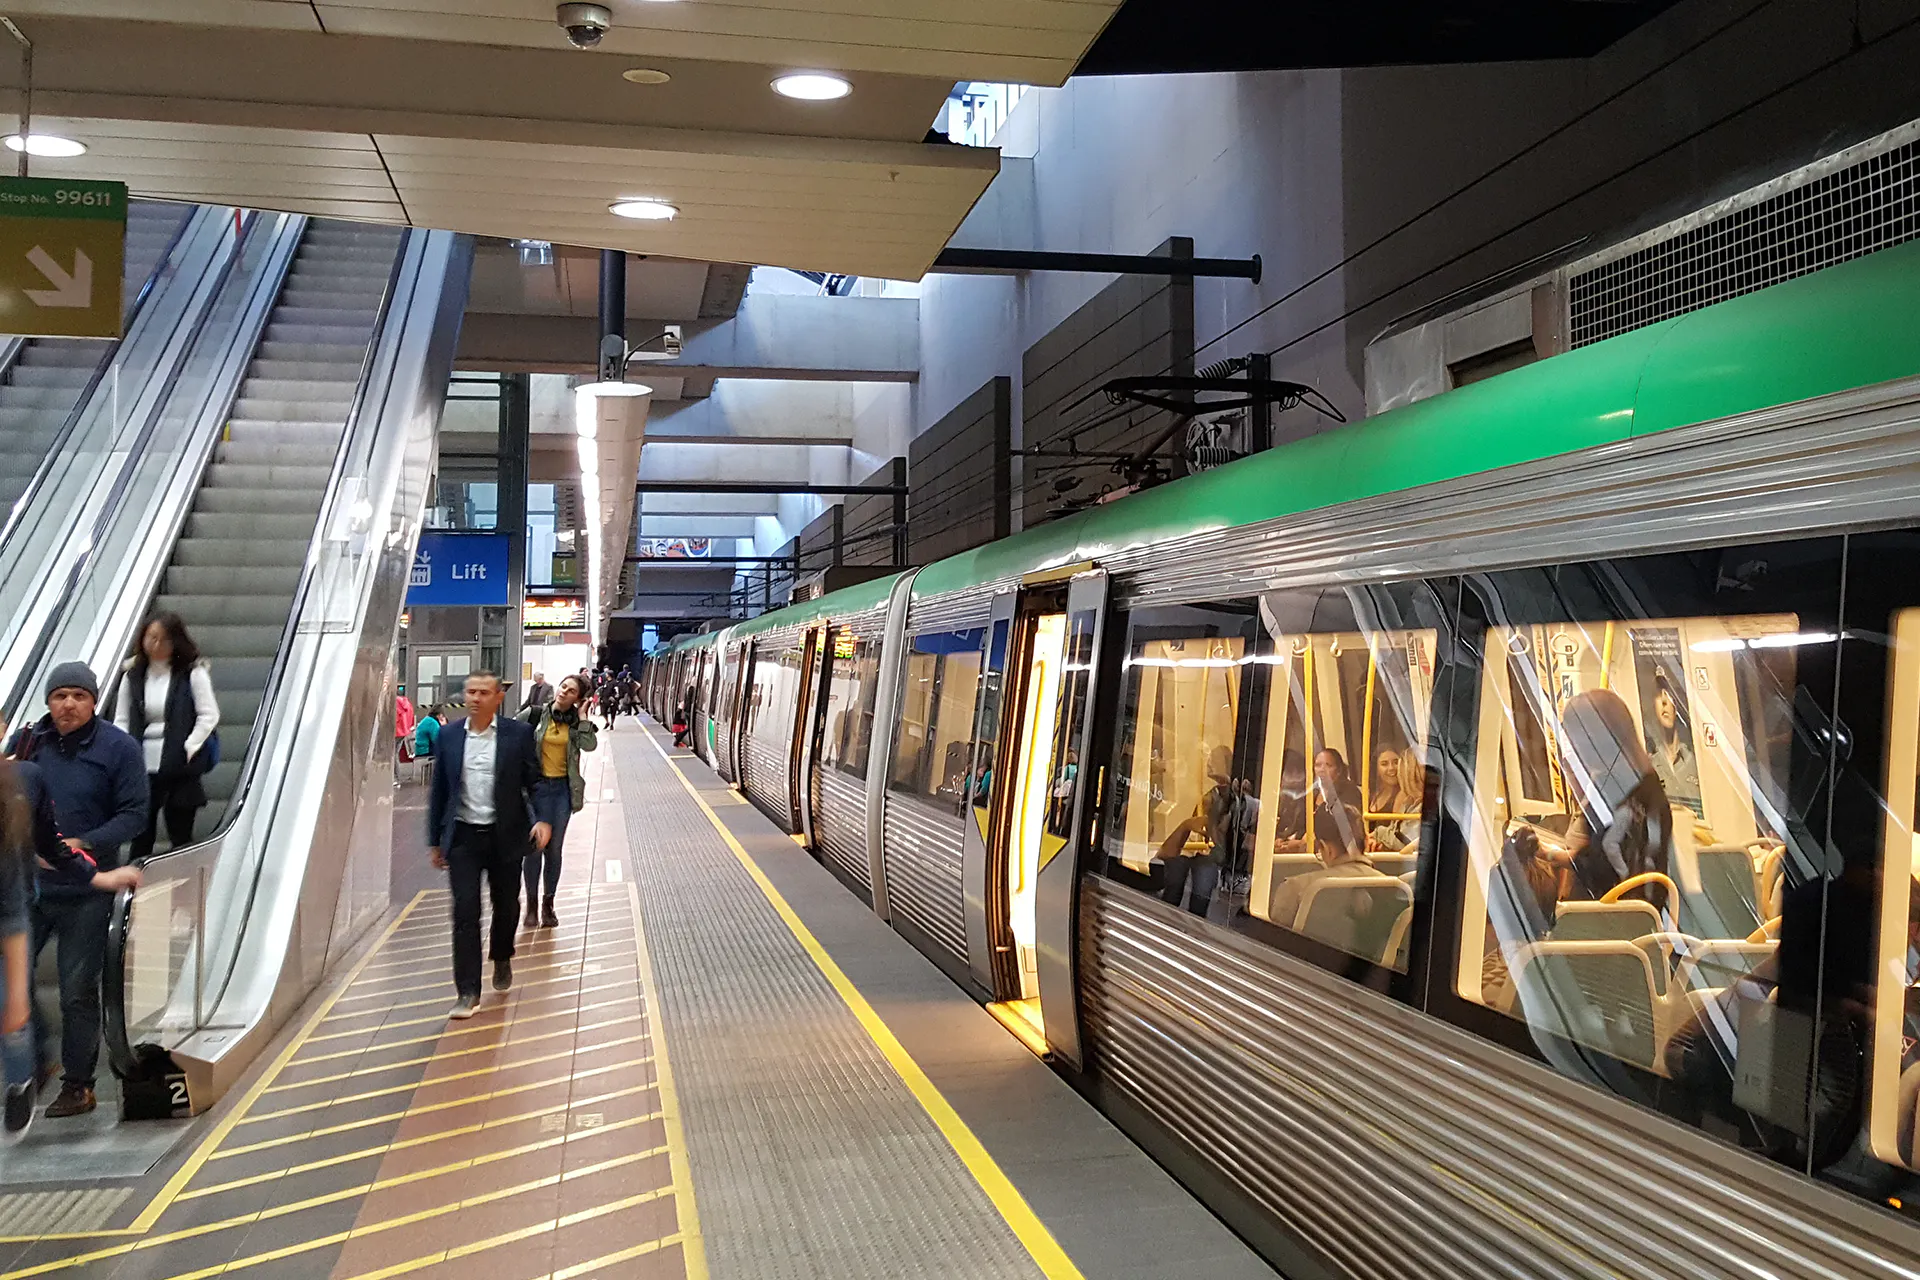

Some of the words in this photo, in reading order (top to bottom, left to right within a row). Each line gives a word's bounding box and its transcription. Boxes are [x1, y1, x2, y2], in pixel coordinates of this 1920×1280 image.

[0, 192, 28, 204] Stop
[54, 189, 111, 207] 99611
[452, 563, 487, 581] Lift
[560, 559, 568, 573] 1
[168, 1081, 188, 1105] 2
